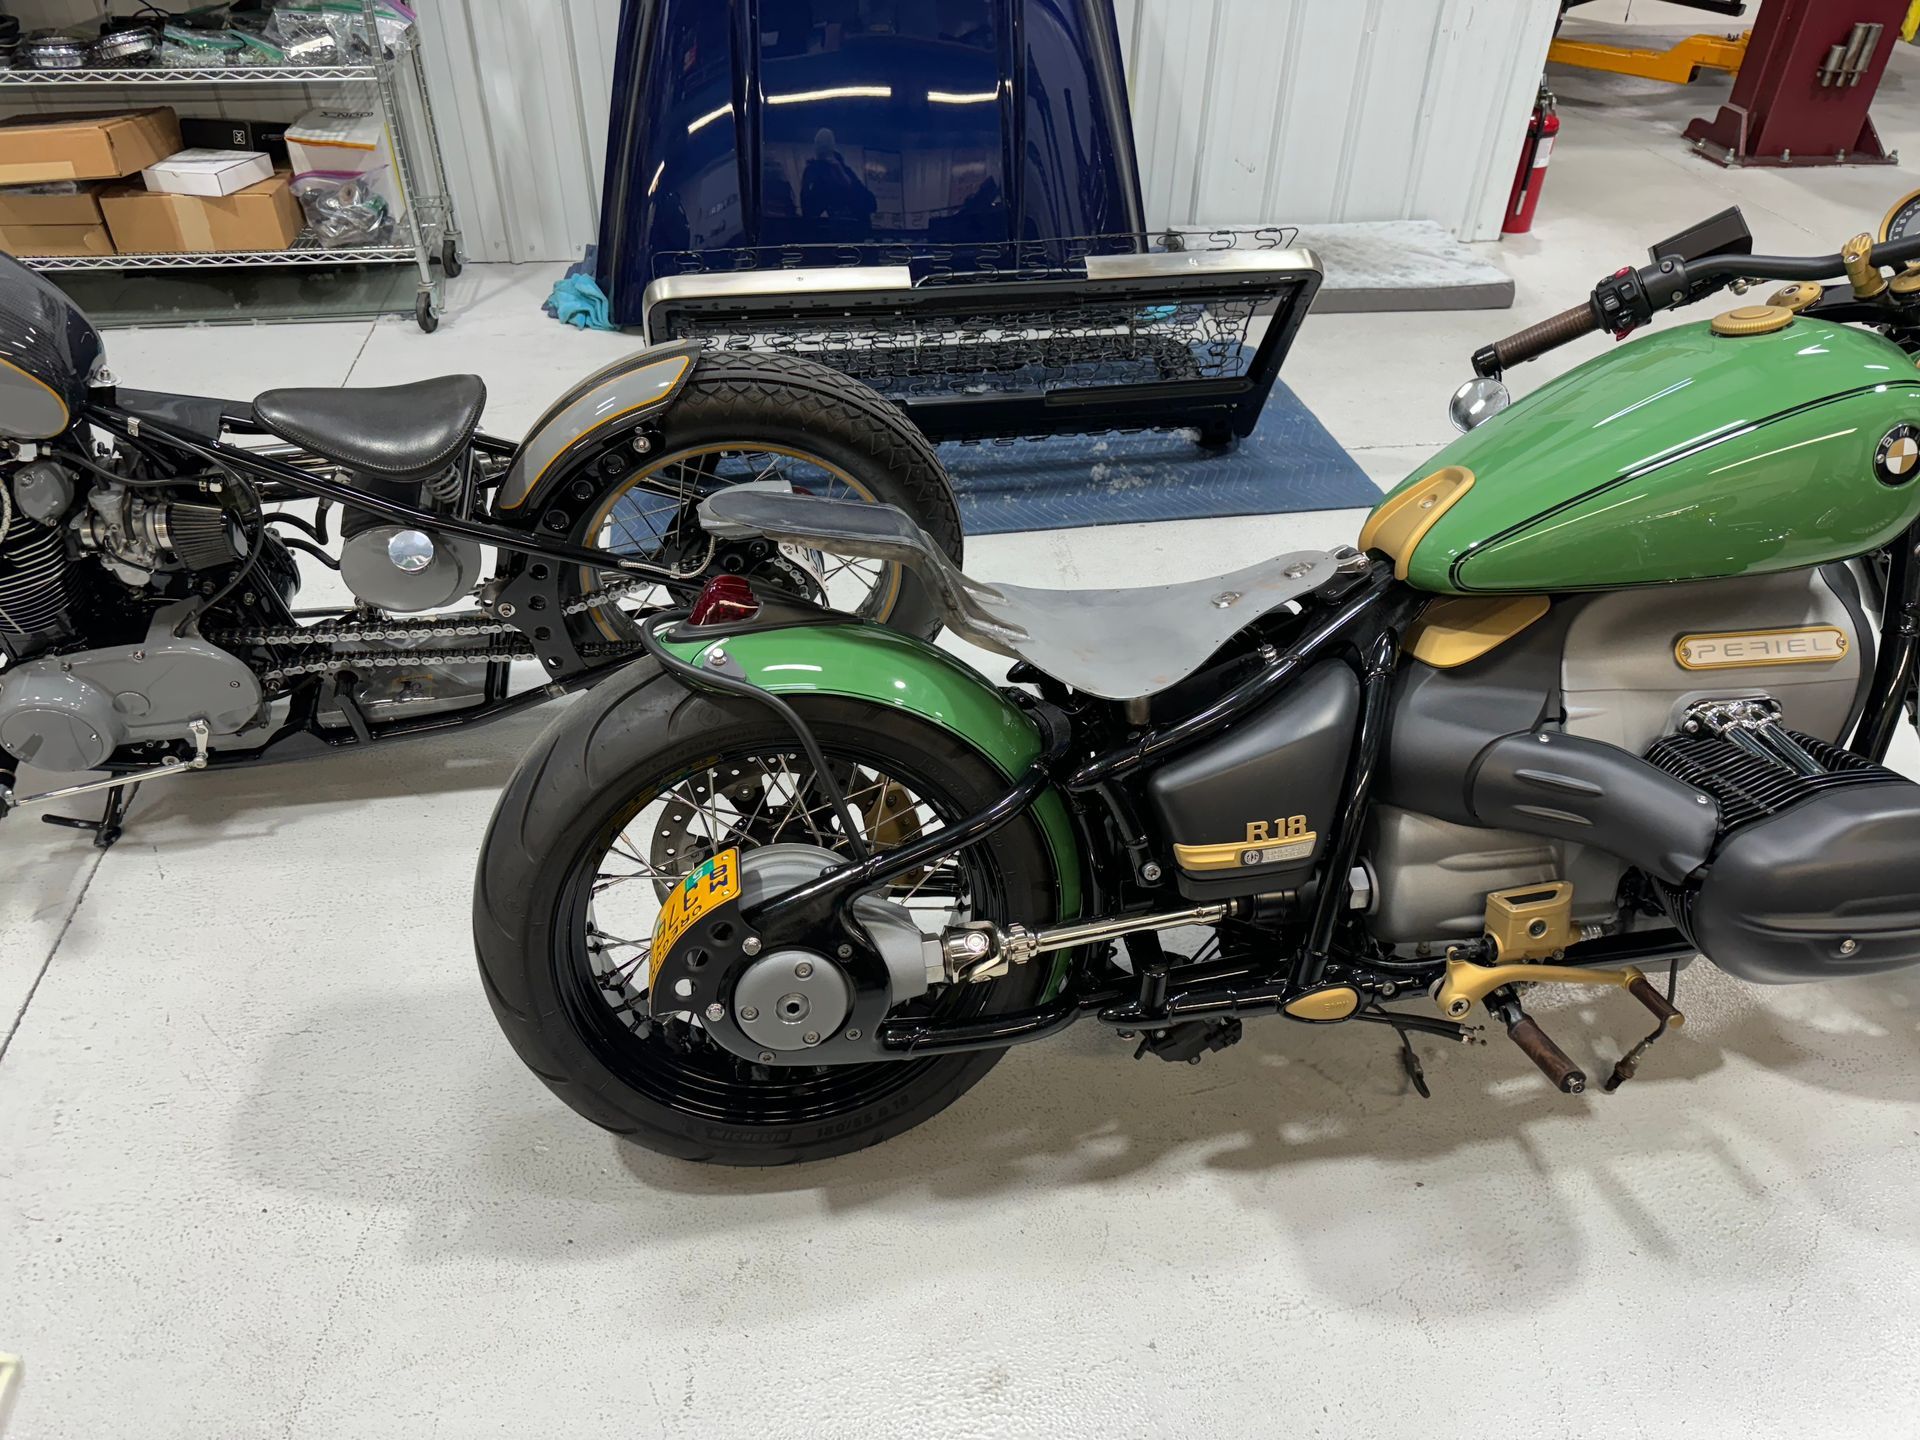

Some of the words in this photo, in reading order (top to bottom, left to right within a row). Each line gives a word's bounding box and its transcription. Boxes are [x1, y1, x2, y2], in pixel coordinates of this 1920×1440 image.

[1697, 638, 1832, 659] PERIEL
[1246, 820, 1269, 843] R
[1274, 815, 1307, 840] 18
